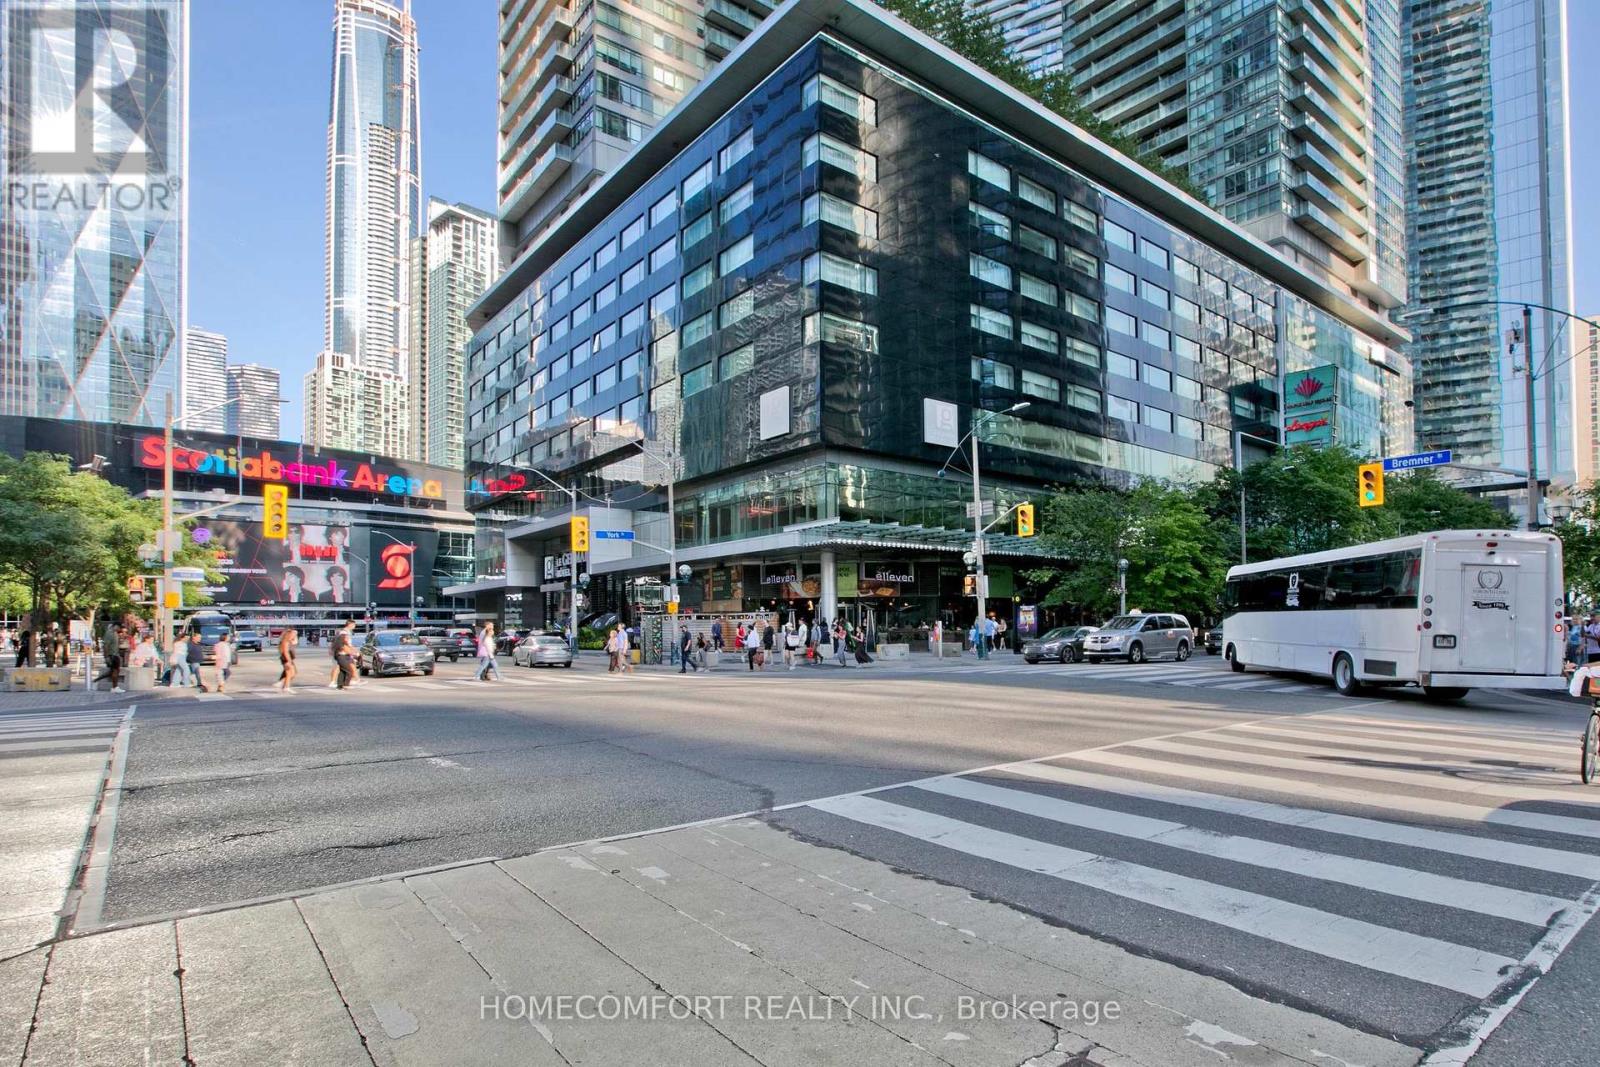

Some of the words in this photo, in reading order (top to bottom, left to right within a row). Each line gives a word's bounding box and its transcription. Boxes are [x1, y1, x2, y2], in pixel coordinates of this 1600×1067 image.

[141, 434, 348, 488] Scotiabank
[351, 462, 443, 498] Arena
[1391, 455, 1434, 468] Bremner
